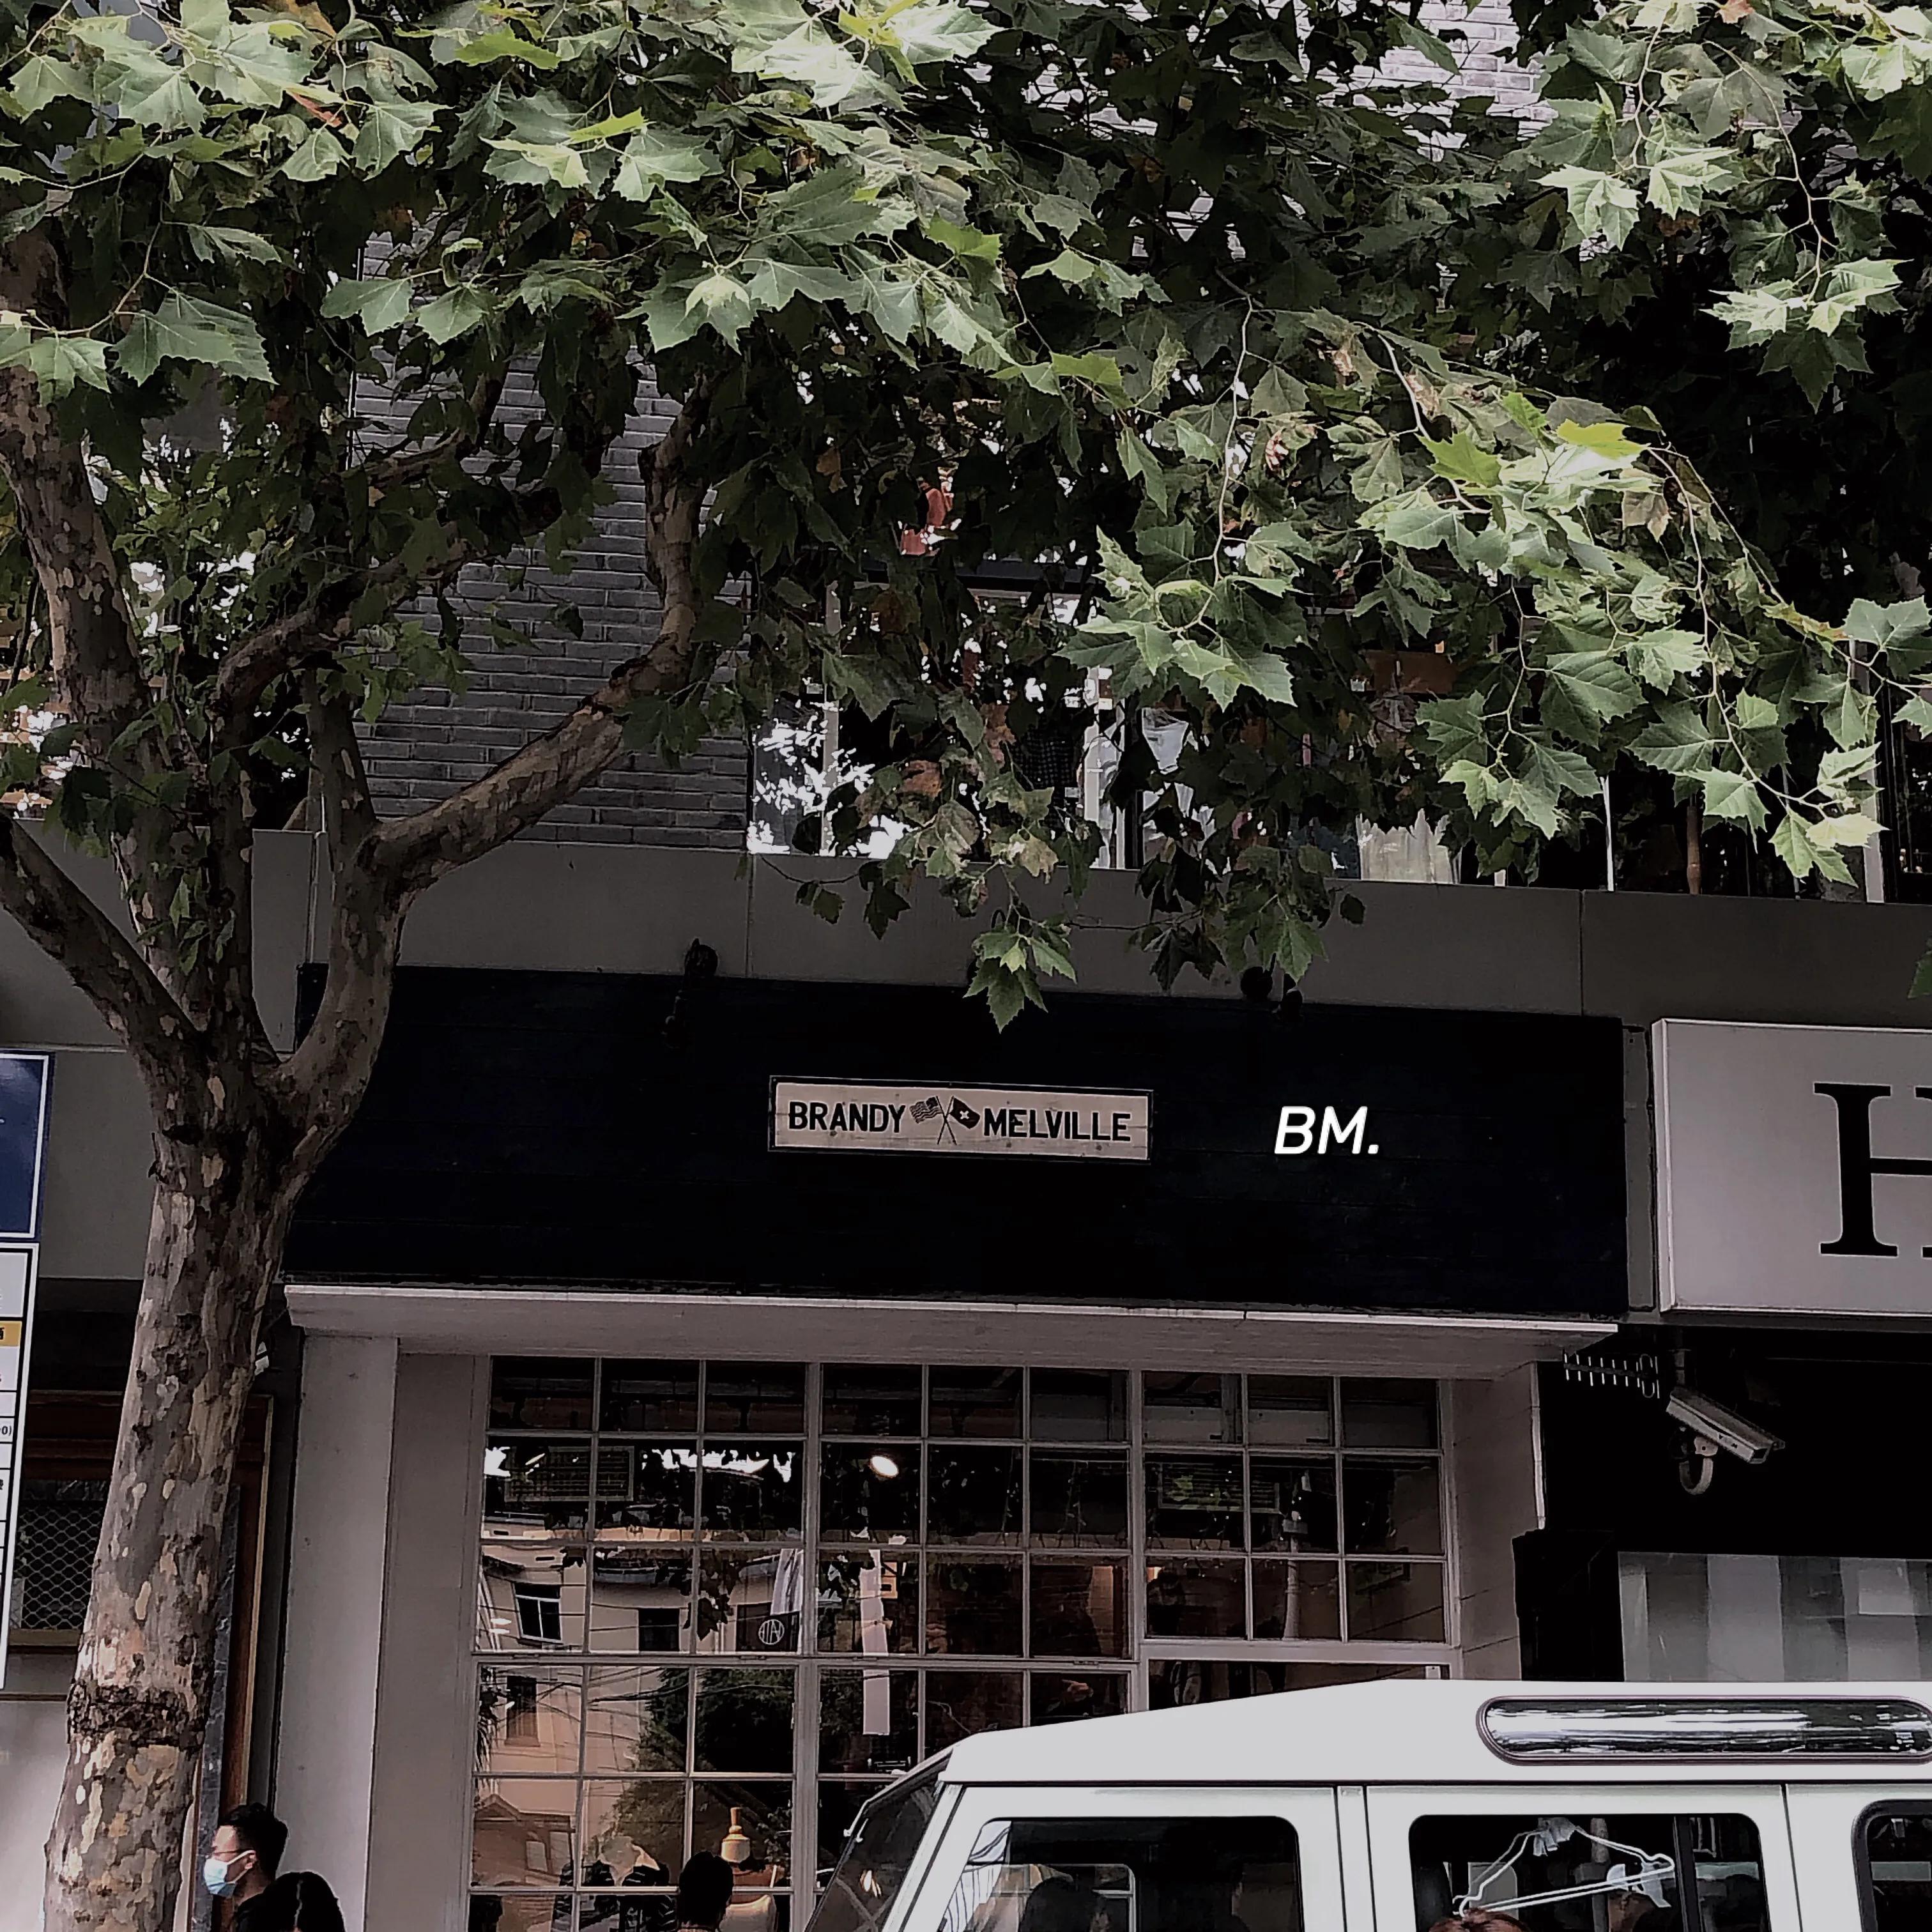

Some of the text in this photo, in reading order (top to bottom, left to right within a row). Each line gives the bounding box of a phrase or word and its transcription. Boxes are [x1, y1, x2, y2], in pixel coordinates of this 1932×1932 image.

[788, 1101, 1131, 1142] BRANDY MELVILLE
[1275, 1106, 1379, 1154] BM.
